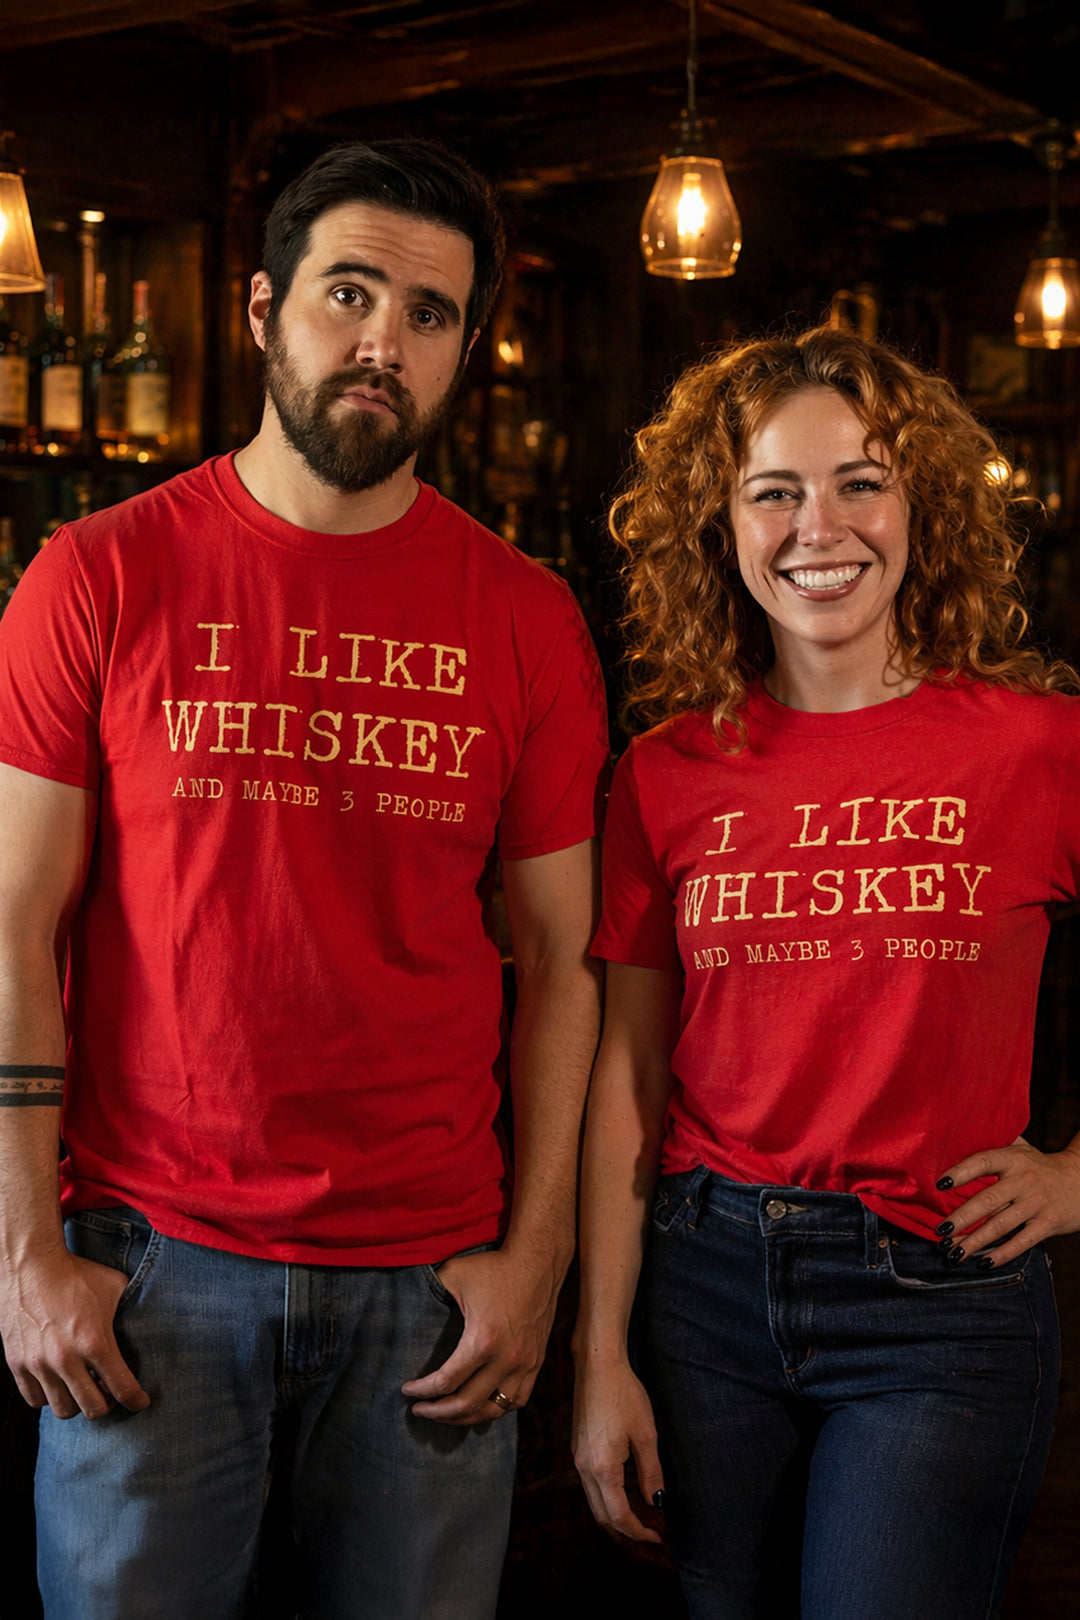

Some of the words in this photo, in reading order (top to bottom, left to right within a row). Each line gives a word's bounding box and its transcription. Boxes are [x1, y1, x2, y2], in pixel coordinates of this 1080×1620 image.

[195, 623, 235, 671] I
[289, 626, 467, 695] LIKE
[162, 700, 486, 778] WHISKEY
[171, 777, 223, 799] AND
[242, 780, 319, 806] MAYBE
[340, 790, 354, 811] 3
[375, 792, 466, 822] PEOPLE
[705, 811, 744, 855] I
[789, 797, 966, 846] LIKE
[685, 863, 992, 927] WHISKEY
[693, 947, 730, 970] AND
[745, 940, 831, 964] MAYBE
[851, 940, 864, 961] 3
[884, 938, 981, 961] PEOPLE
